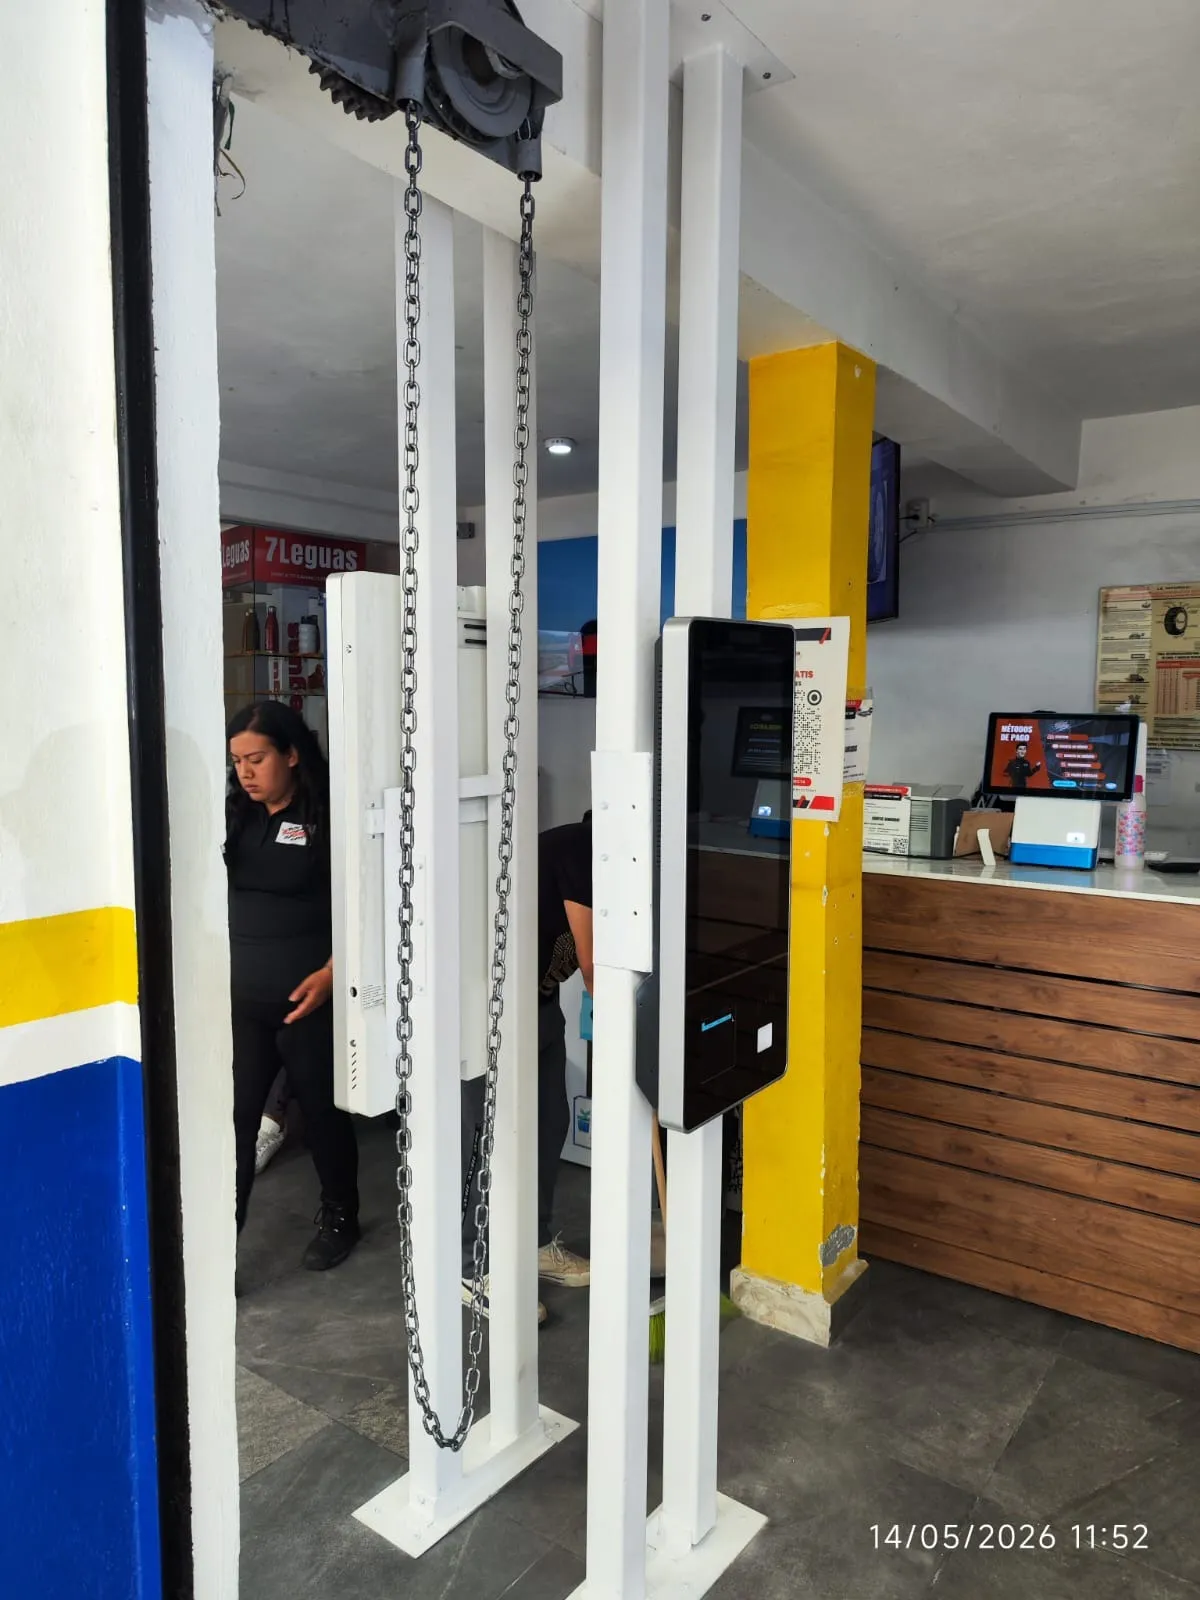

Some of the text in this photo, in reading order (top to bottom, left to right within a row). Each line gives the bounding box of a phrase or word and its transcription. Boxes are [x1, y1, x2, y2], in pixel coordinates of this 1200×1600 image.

[265, 536, 358, 571] 7Leguas
[1001, 723, 1033, 734] MÉTODOS
[1000, 733, 1030, 742] DE PAGO
